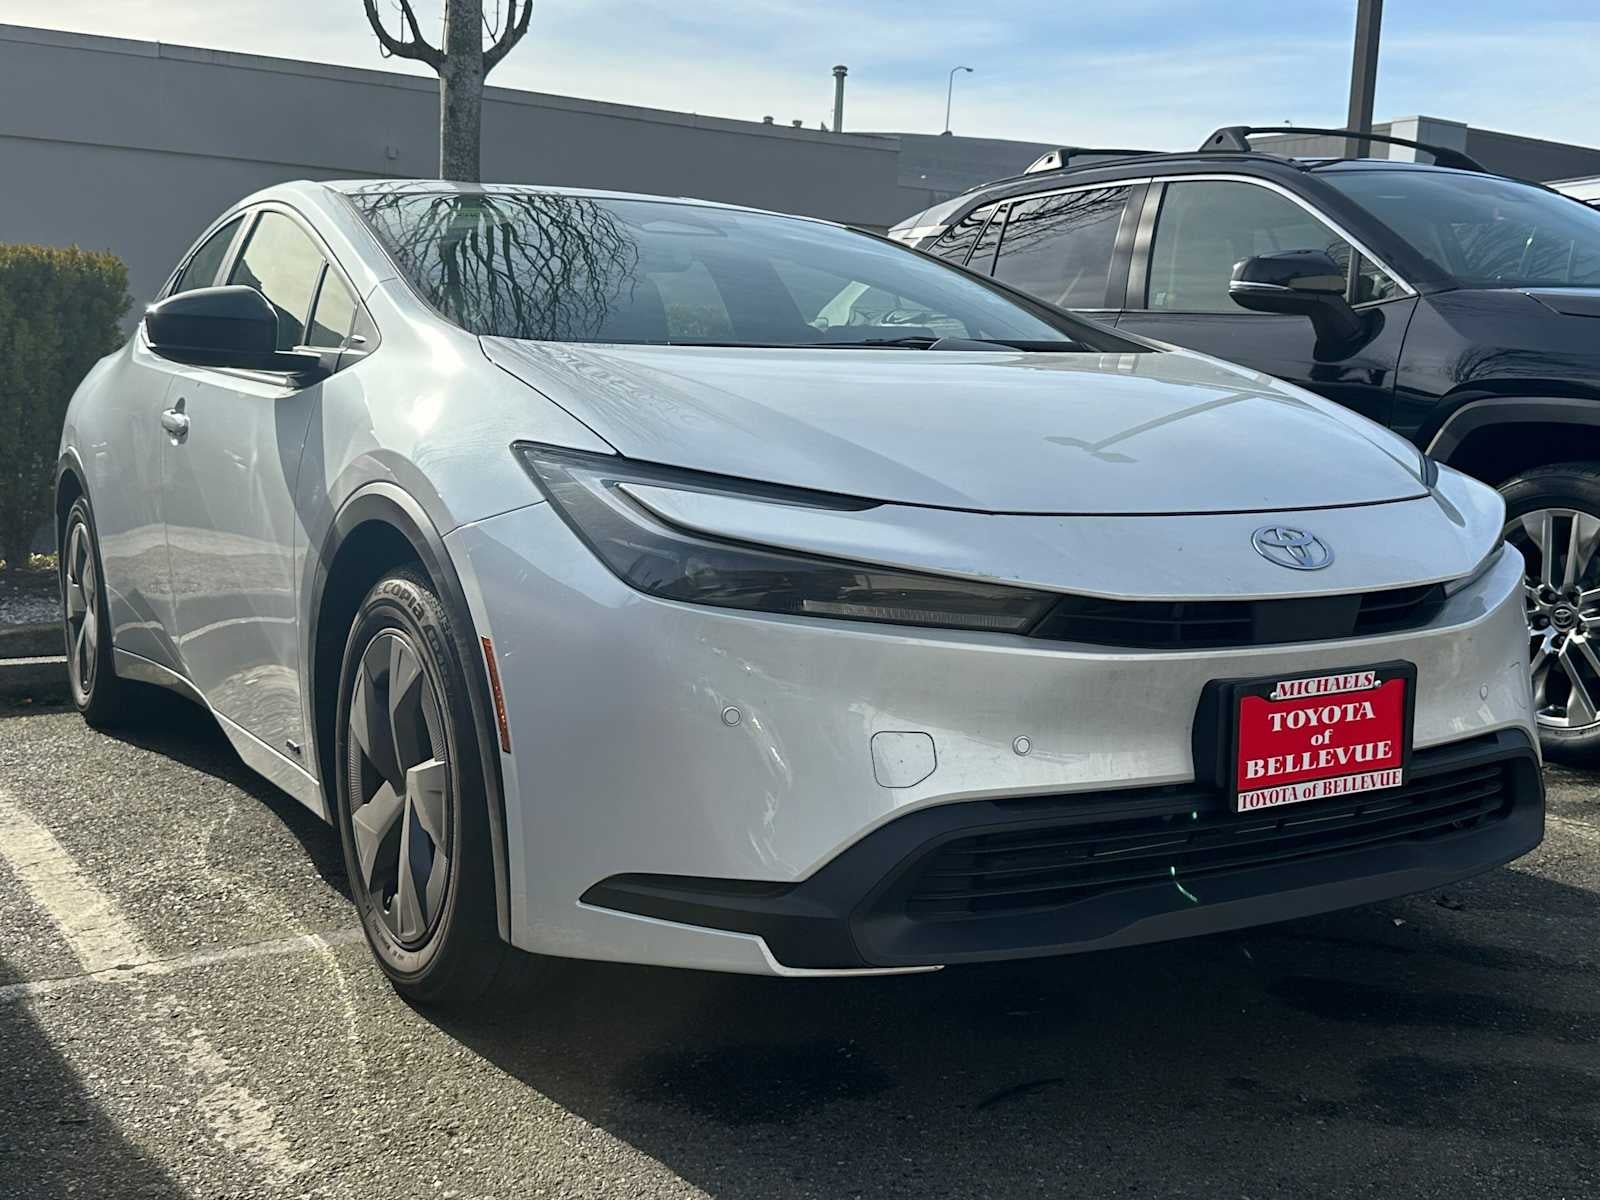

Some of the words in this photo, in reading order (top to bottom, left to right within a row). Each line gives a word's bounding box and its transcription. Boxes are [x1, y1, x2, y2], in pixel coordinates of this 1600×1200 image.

[1278, 673, 1373, 697] MICHAELS
[1268, 701, 1376, 732] TOYOTA
[1311, 729, 1333, 746] of
[1245, 740, 1393, 779] BELLEVUE
[1240, 786, 1298, 809] TOYOTA
[1303, 784, 1319, 798] of
[1322, 770, 1401, 796] BELLEVUE
